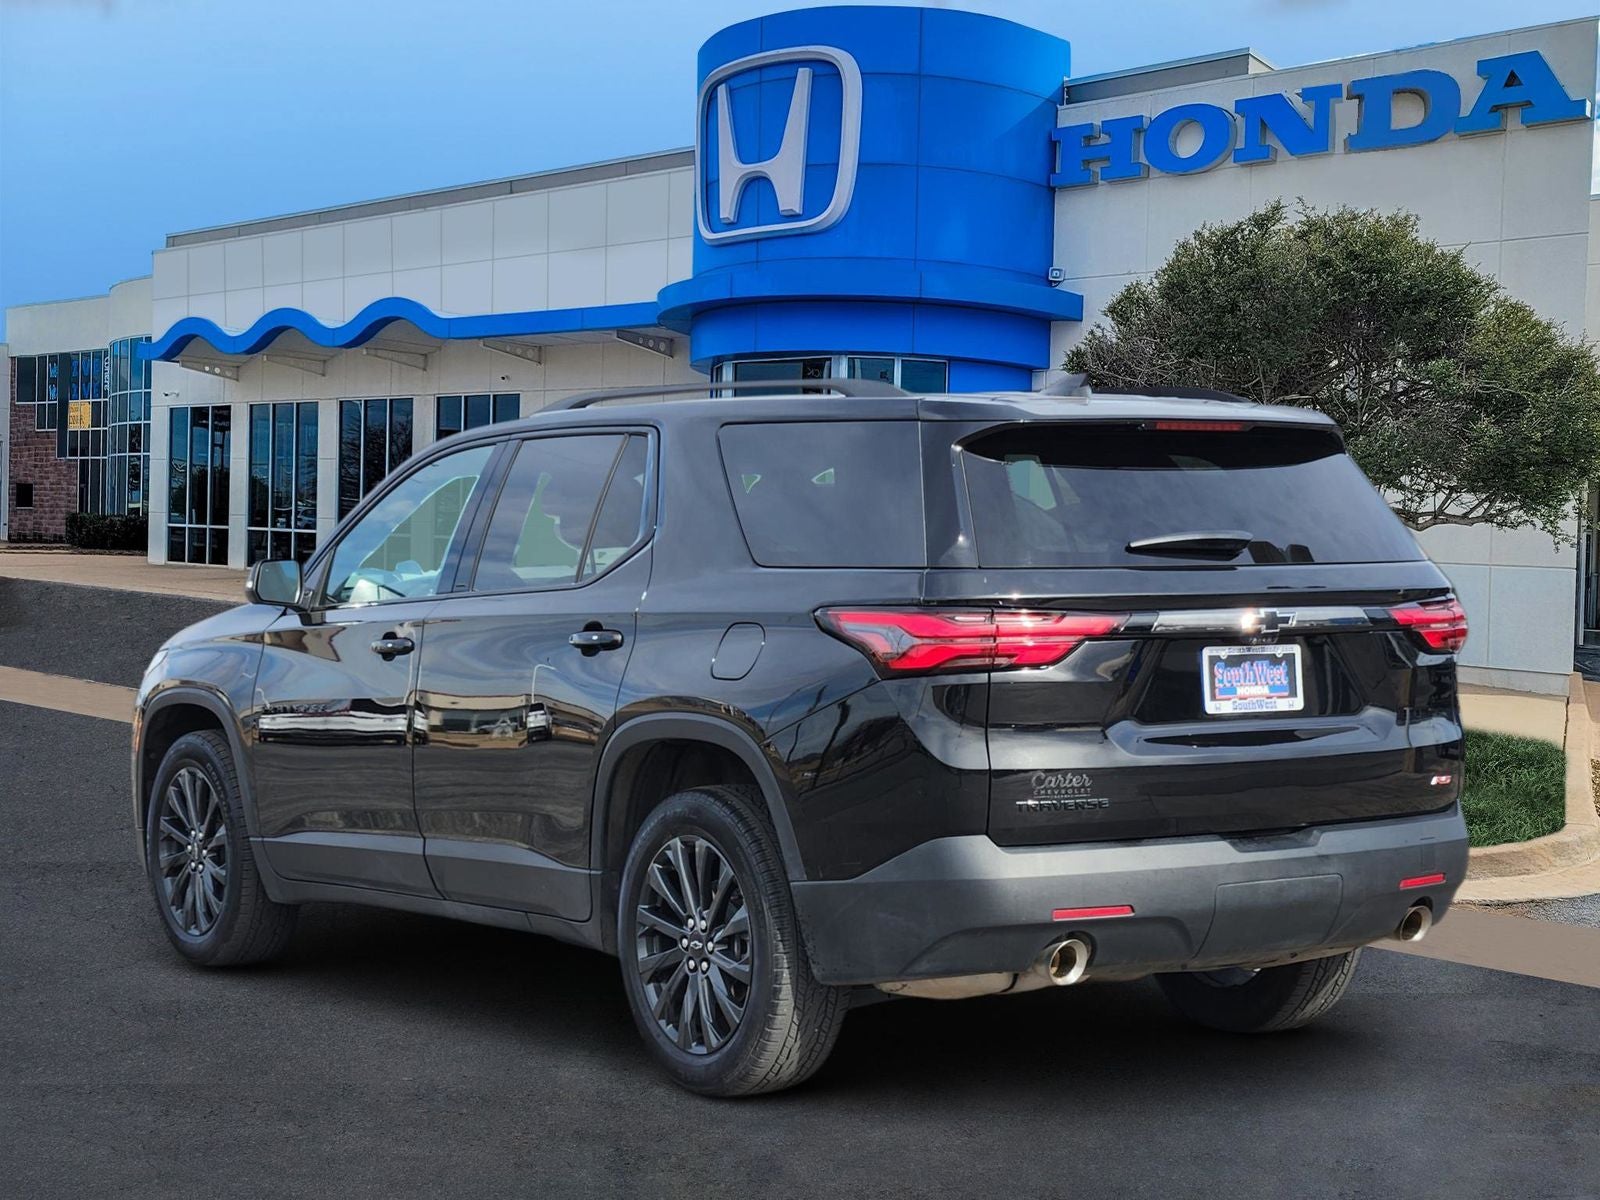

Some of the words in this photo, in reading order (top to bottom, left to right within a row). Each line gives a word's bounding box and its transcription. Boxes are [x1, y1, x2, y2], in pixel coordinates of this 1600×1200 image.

[1050, 49, 1591, 189] HONDA
[1214, 660, 1289, 687] SouthWest
[1232, 699, 1278, 711] SouthWest
[1031, 771, 1093, 789] Carter
[1015, 797, 1110, 812] TRAVERSE
